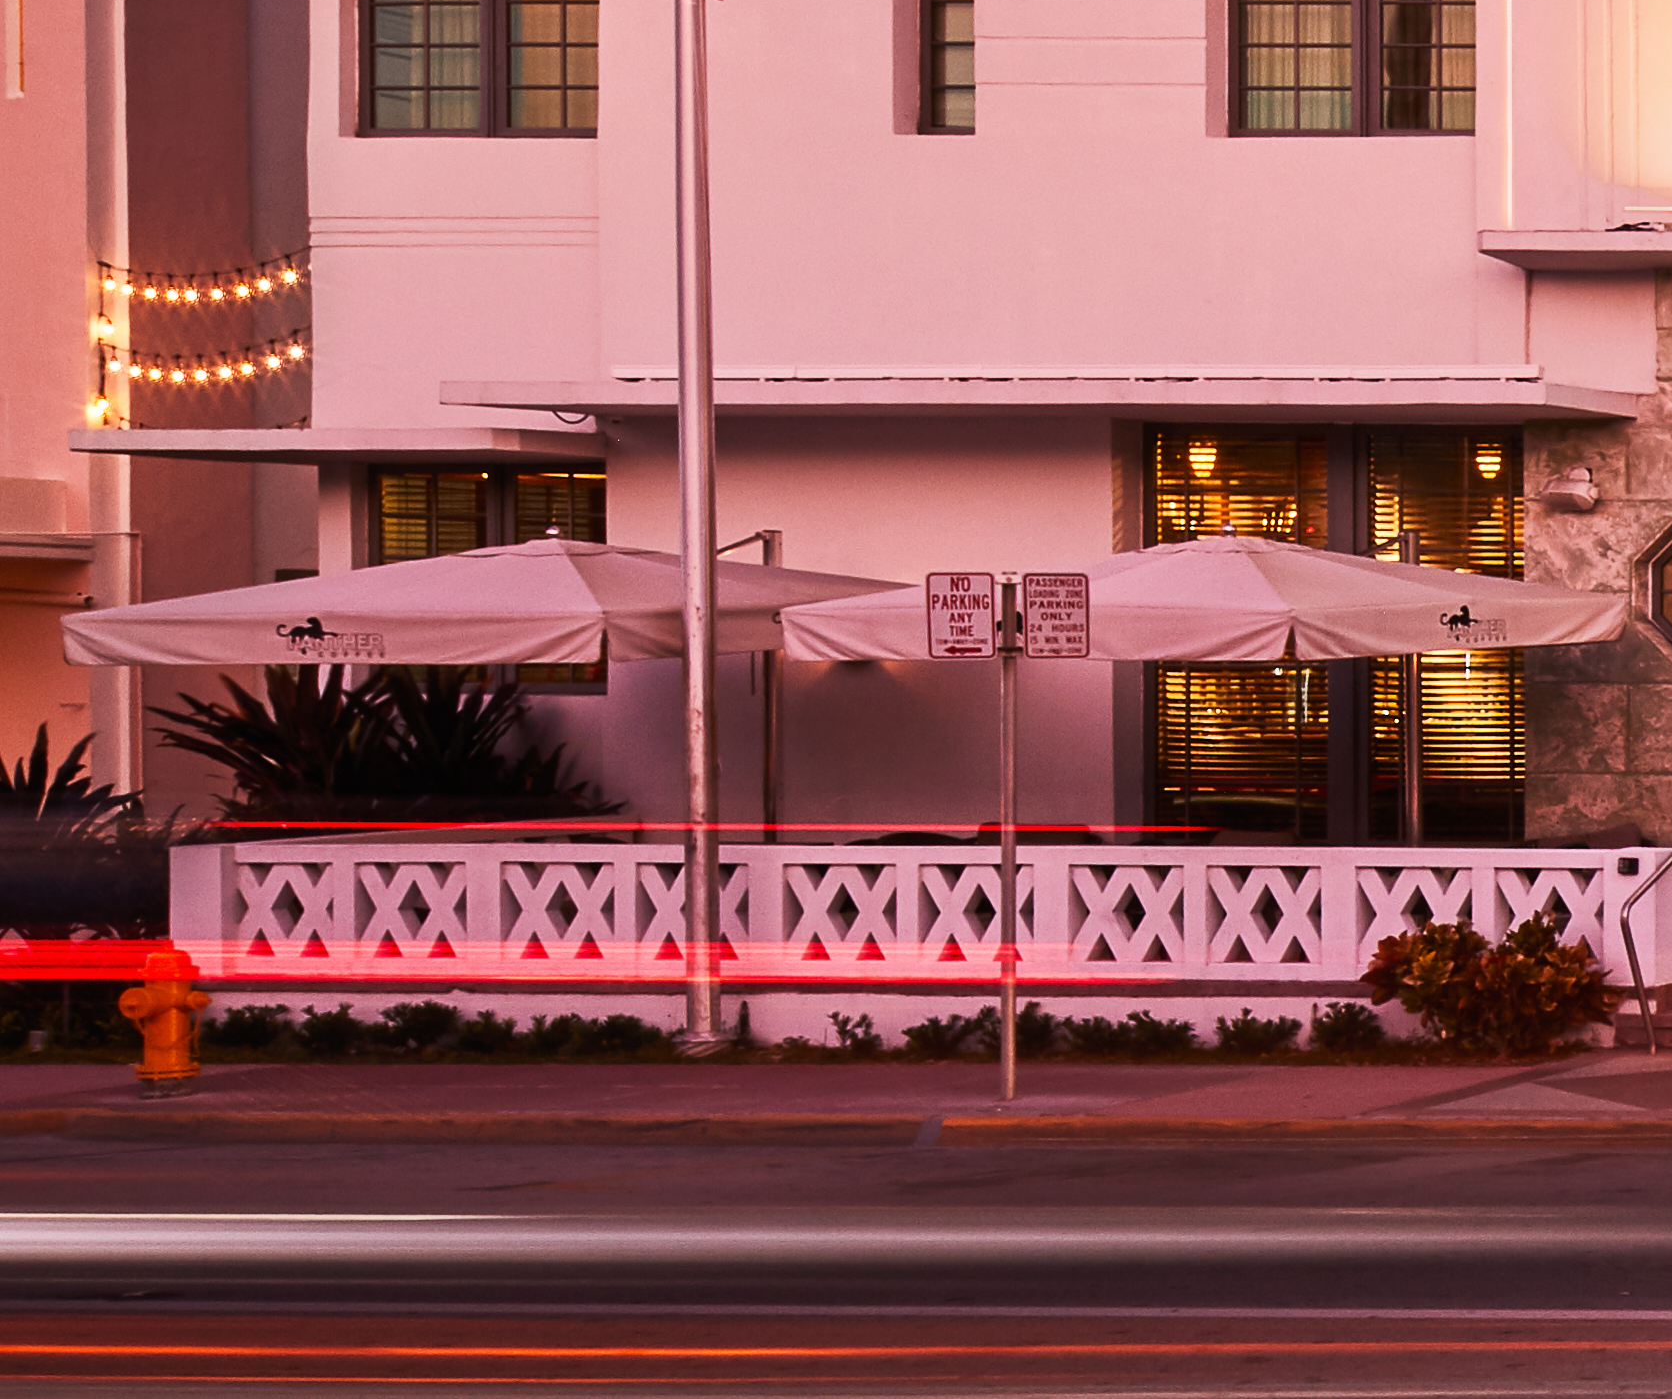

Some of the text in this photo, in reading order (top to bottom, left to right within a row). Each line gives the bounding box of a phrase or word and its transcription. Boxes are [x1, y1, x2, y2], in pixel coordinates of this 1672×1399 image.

[950, 577, 971, 592] NO
[1028, 578, 1083, 587] PASSENGER
[932, 594, 990, 610] PARKING
[1029, 600, 1084, 609] PARKING
[949, 612, 974, 623] ANY
[1041, 612, 1072, 620] ONLY
[949, 625, 974, 636] TIME
[1029, 623, 1084, 633] 24 HOURS
